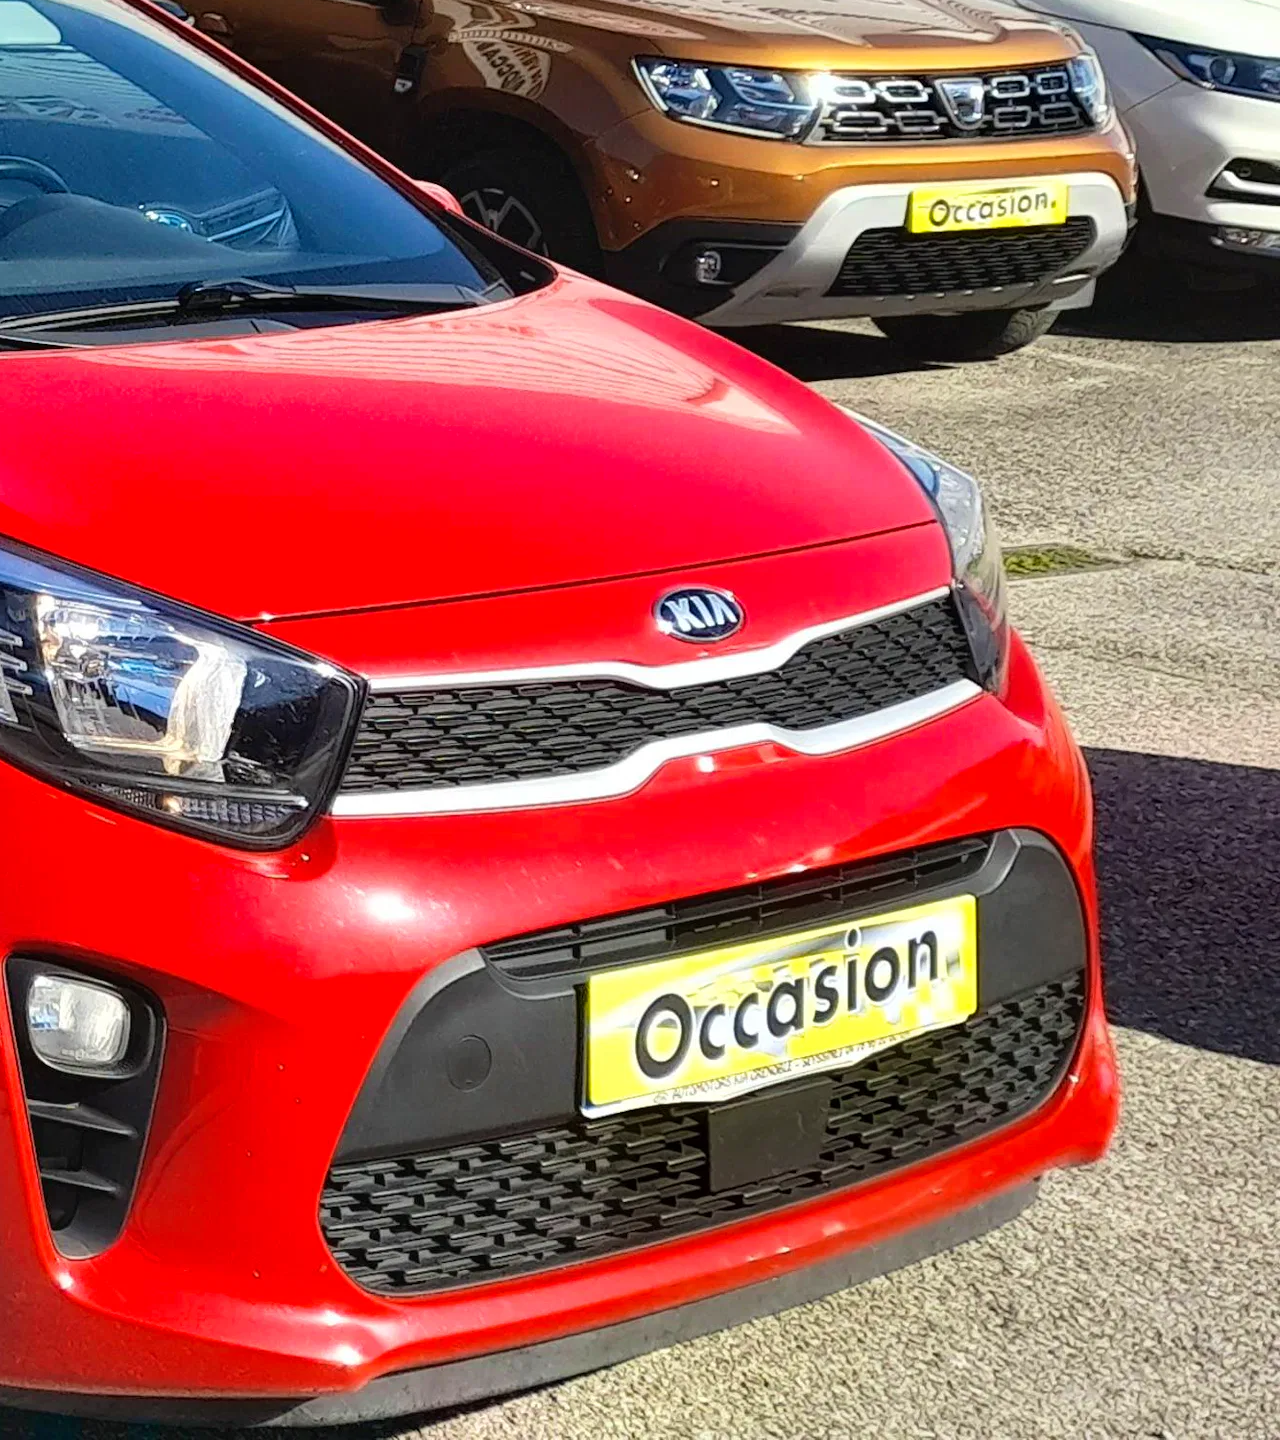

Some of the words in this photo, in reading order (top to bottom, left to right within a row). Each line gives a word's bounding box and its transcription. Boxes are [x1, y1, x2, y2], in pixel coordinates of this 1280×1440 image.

[928, 192, 1048, 227] Occasion
[664, 593, 739, 632] KIA
[635, 928, 939, 1079] Occasion
